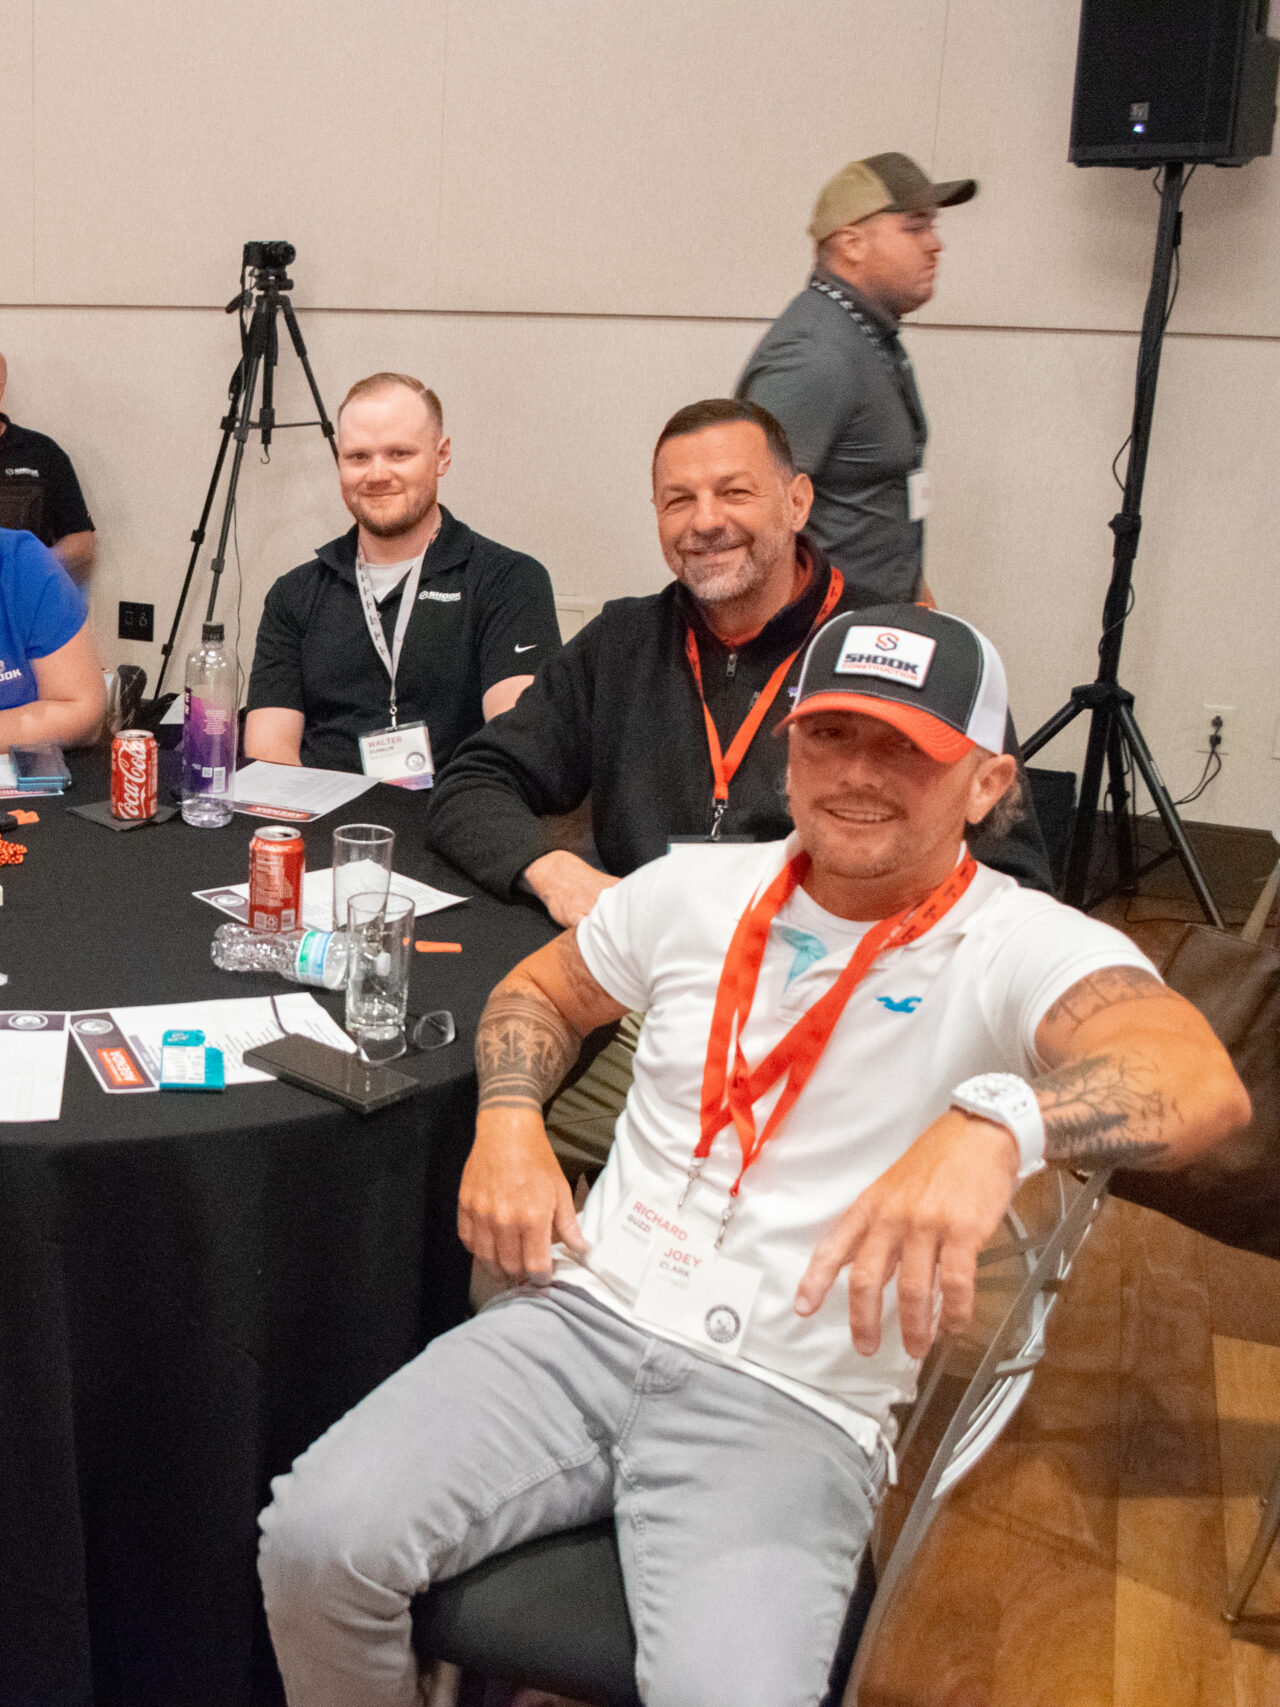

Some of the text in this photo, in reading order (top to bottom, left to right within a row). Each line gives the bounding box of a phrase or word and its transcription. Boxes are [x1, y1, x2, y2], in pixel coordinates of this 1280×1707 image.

[841, 661, 918, 681] CONSTRUCTION
[845, 653, 919, 675] SHOOK
[368, 735, 402, 748] WALTER
[633, 1201, 688, 1241] RICHARD
[663, 1248, 702, 1268] JOEY
[659, 1260, 690, 1278] CLARK
